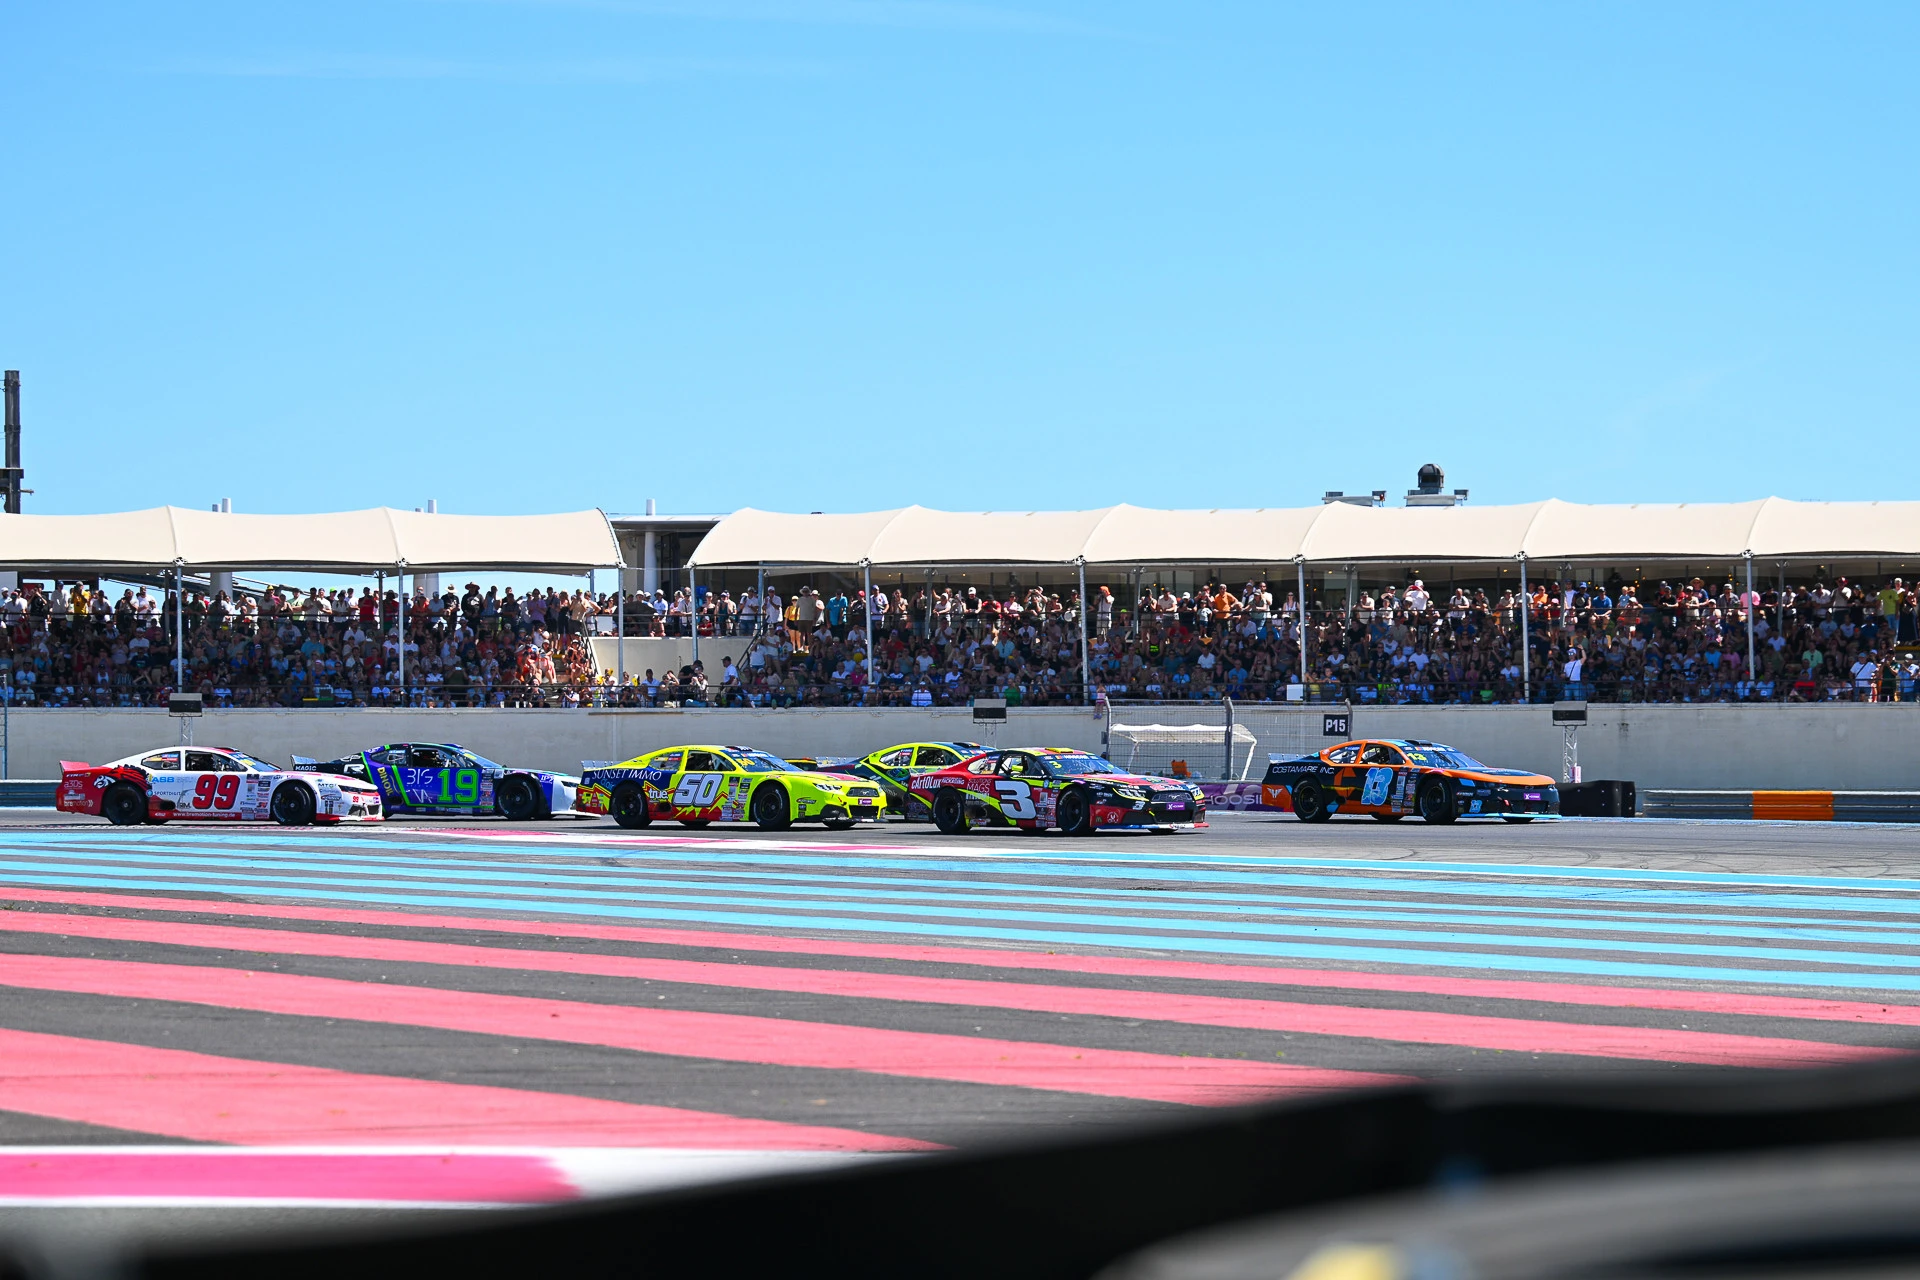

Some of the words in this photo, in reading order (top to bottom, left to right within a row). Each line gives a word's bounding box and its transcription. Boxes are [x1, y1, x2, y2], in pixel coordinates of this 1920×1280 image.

[1325, 719, 1346, 732] P15
[592, 768, 626, 780] SUNSET
[628, 769, 662, 781] IMMO
[1049, 760, 1062, 769] 3
[1272, 766, 1318, 774] COSTAMARE
[192, 774, 241, 810] 99
[437, 768, 479, 804] 19
[672, 773, 724, 807] 50
[967, 783, 990, 793] MAGS
[1361, 767, 1394, 806] 13
[994, 780, 1037, 820] 3
